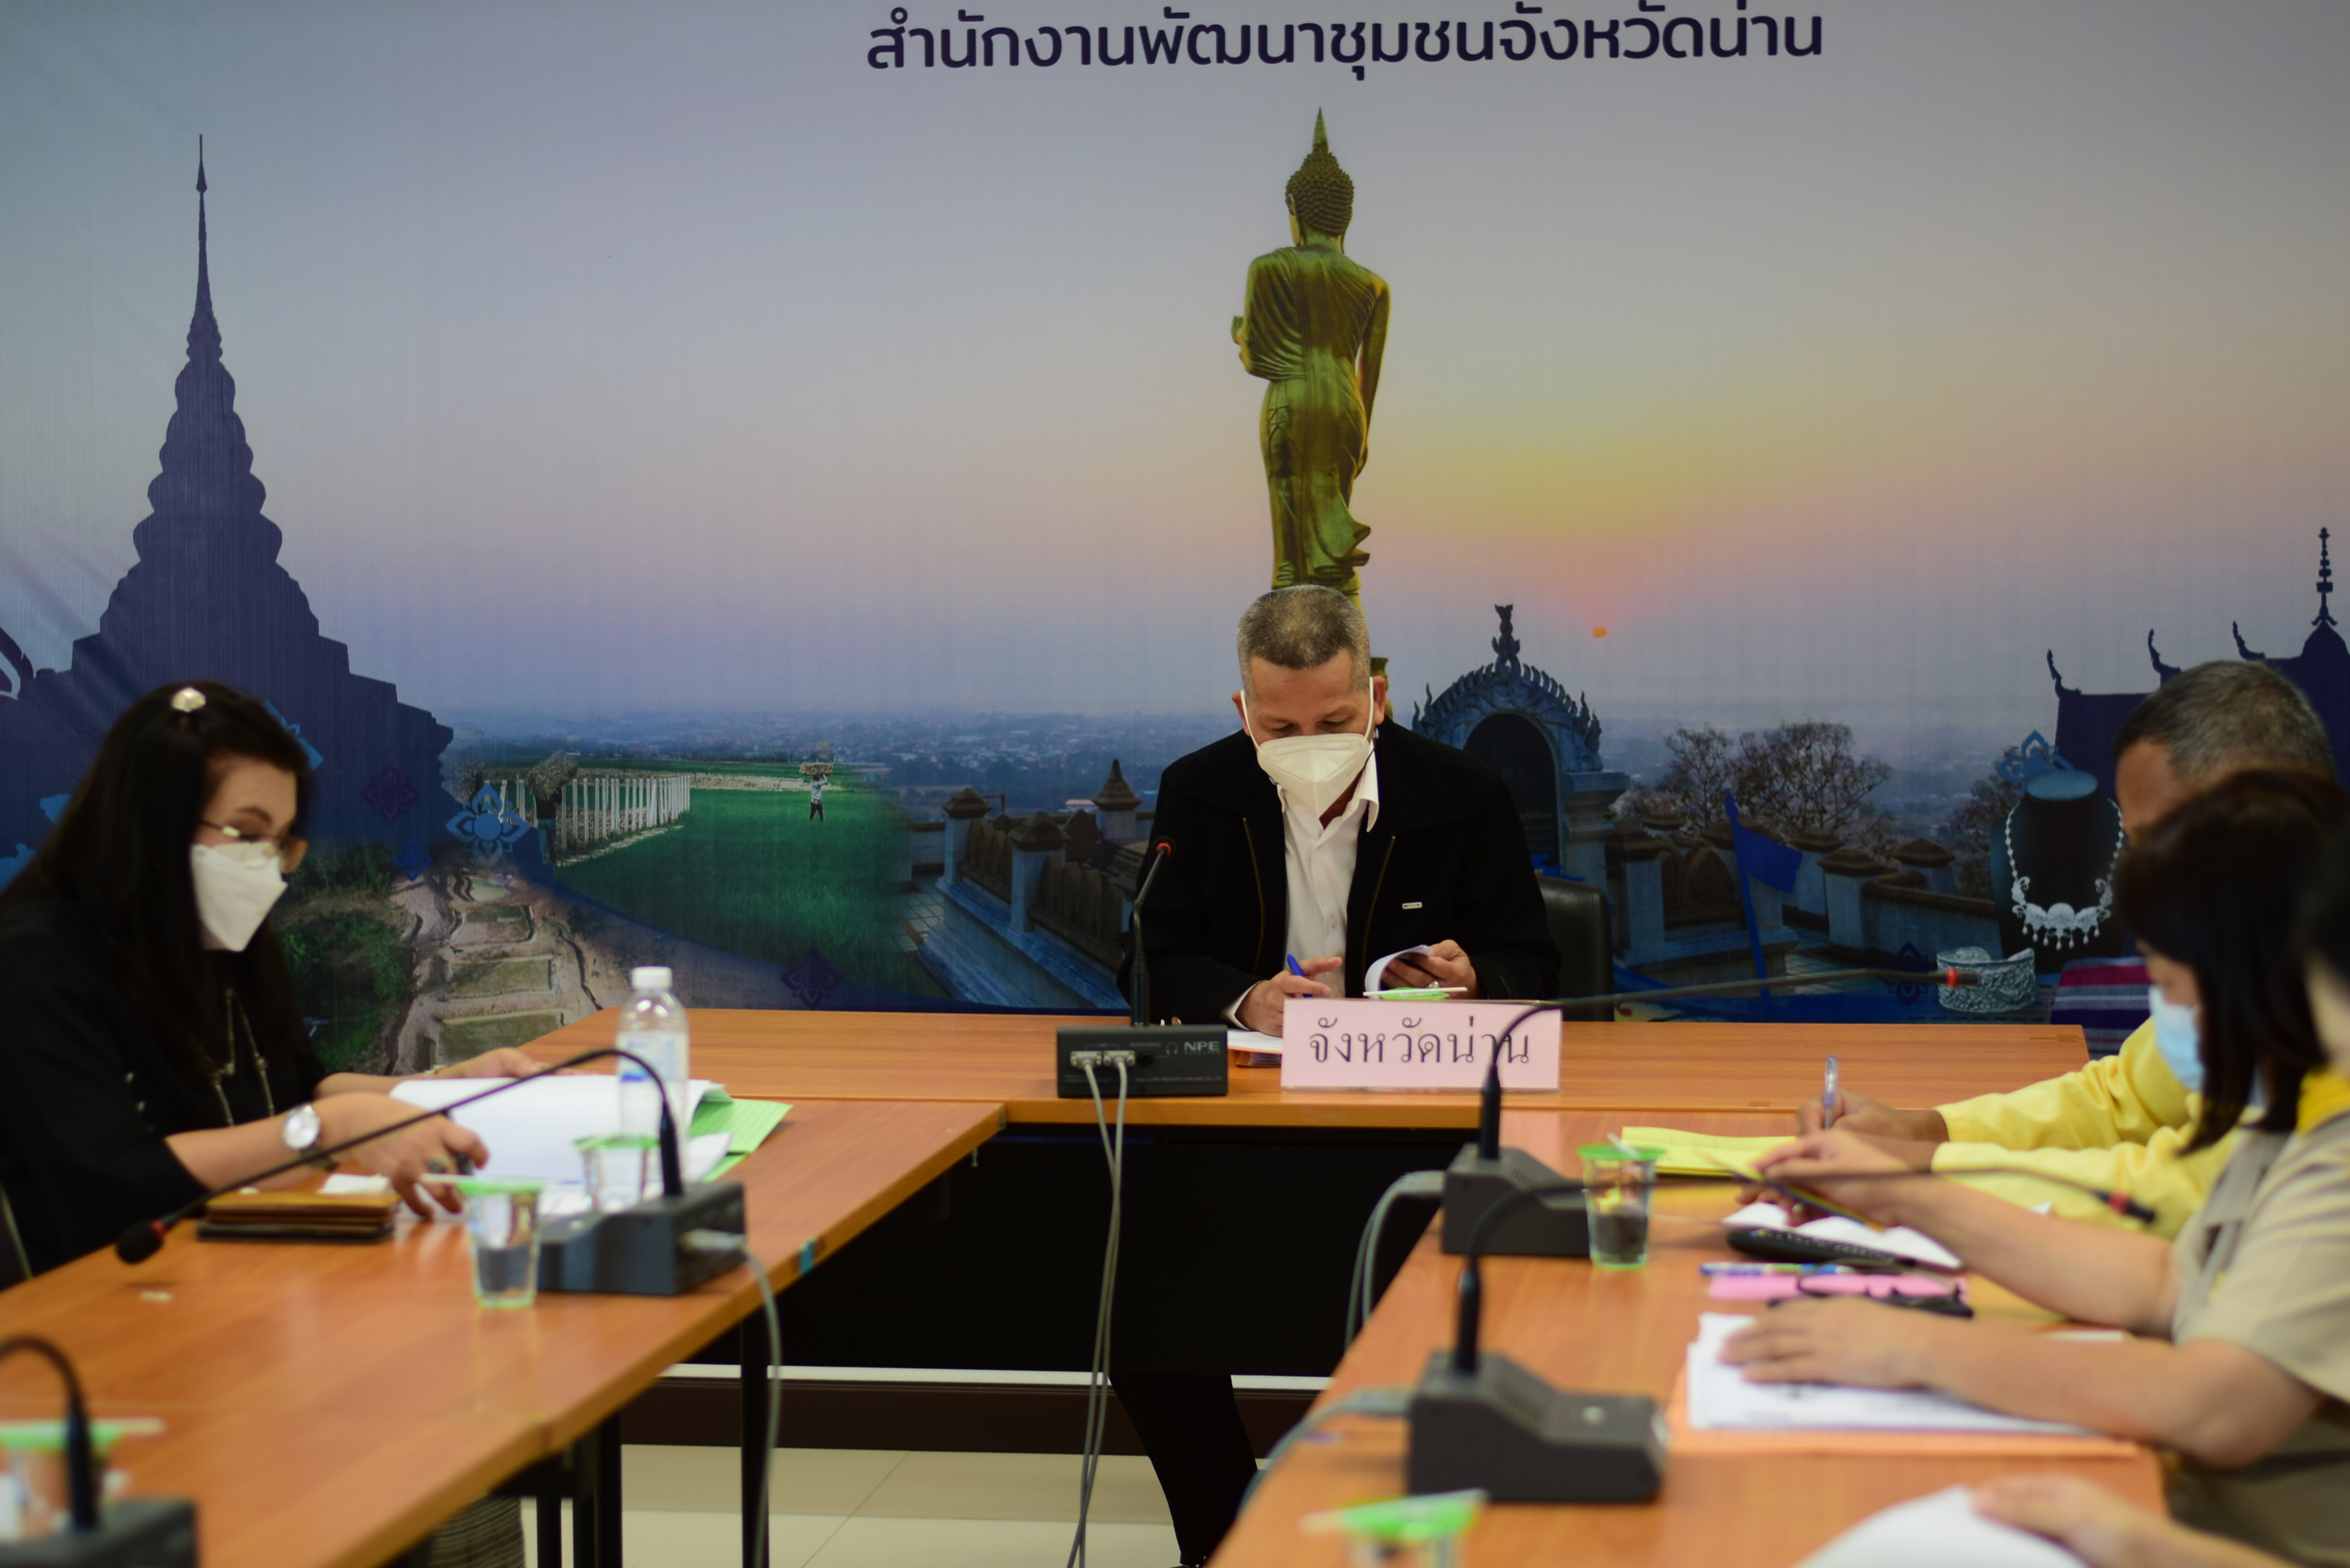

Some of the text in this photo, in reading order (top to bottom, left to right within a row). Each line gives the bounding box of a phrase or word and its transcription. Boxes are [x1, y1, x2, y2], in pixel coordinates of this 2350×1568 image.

[867, 0, 1822, 82] สำนักงานพัฒนาชุมชนจังหวัดน่าน
[1184, 1041, 1220, 1051] NPE
